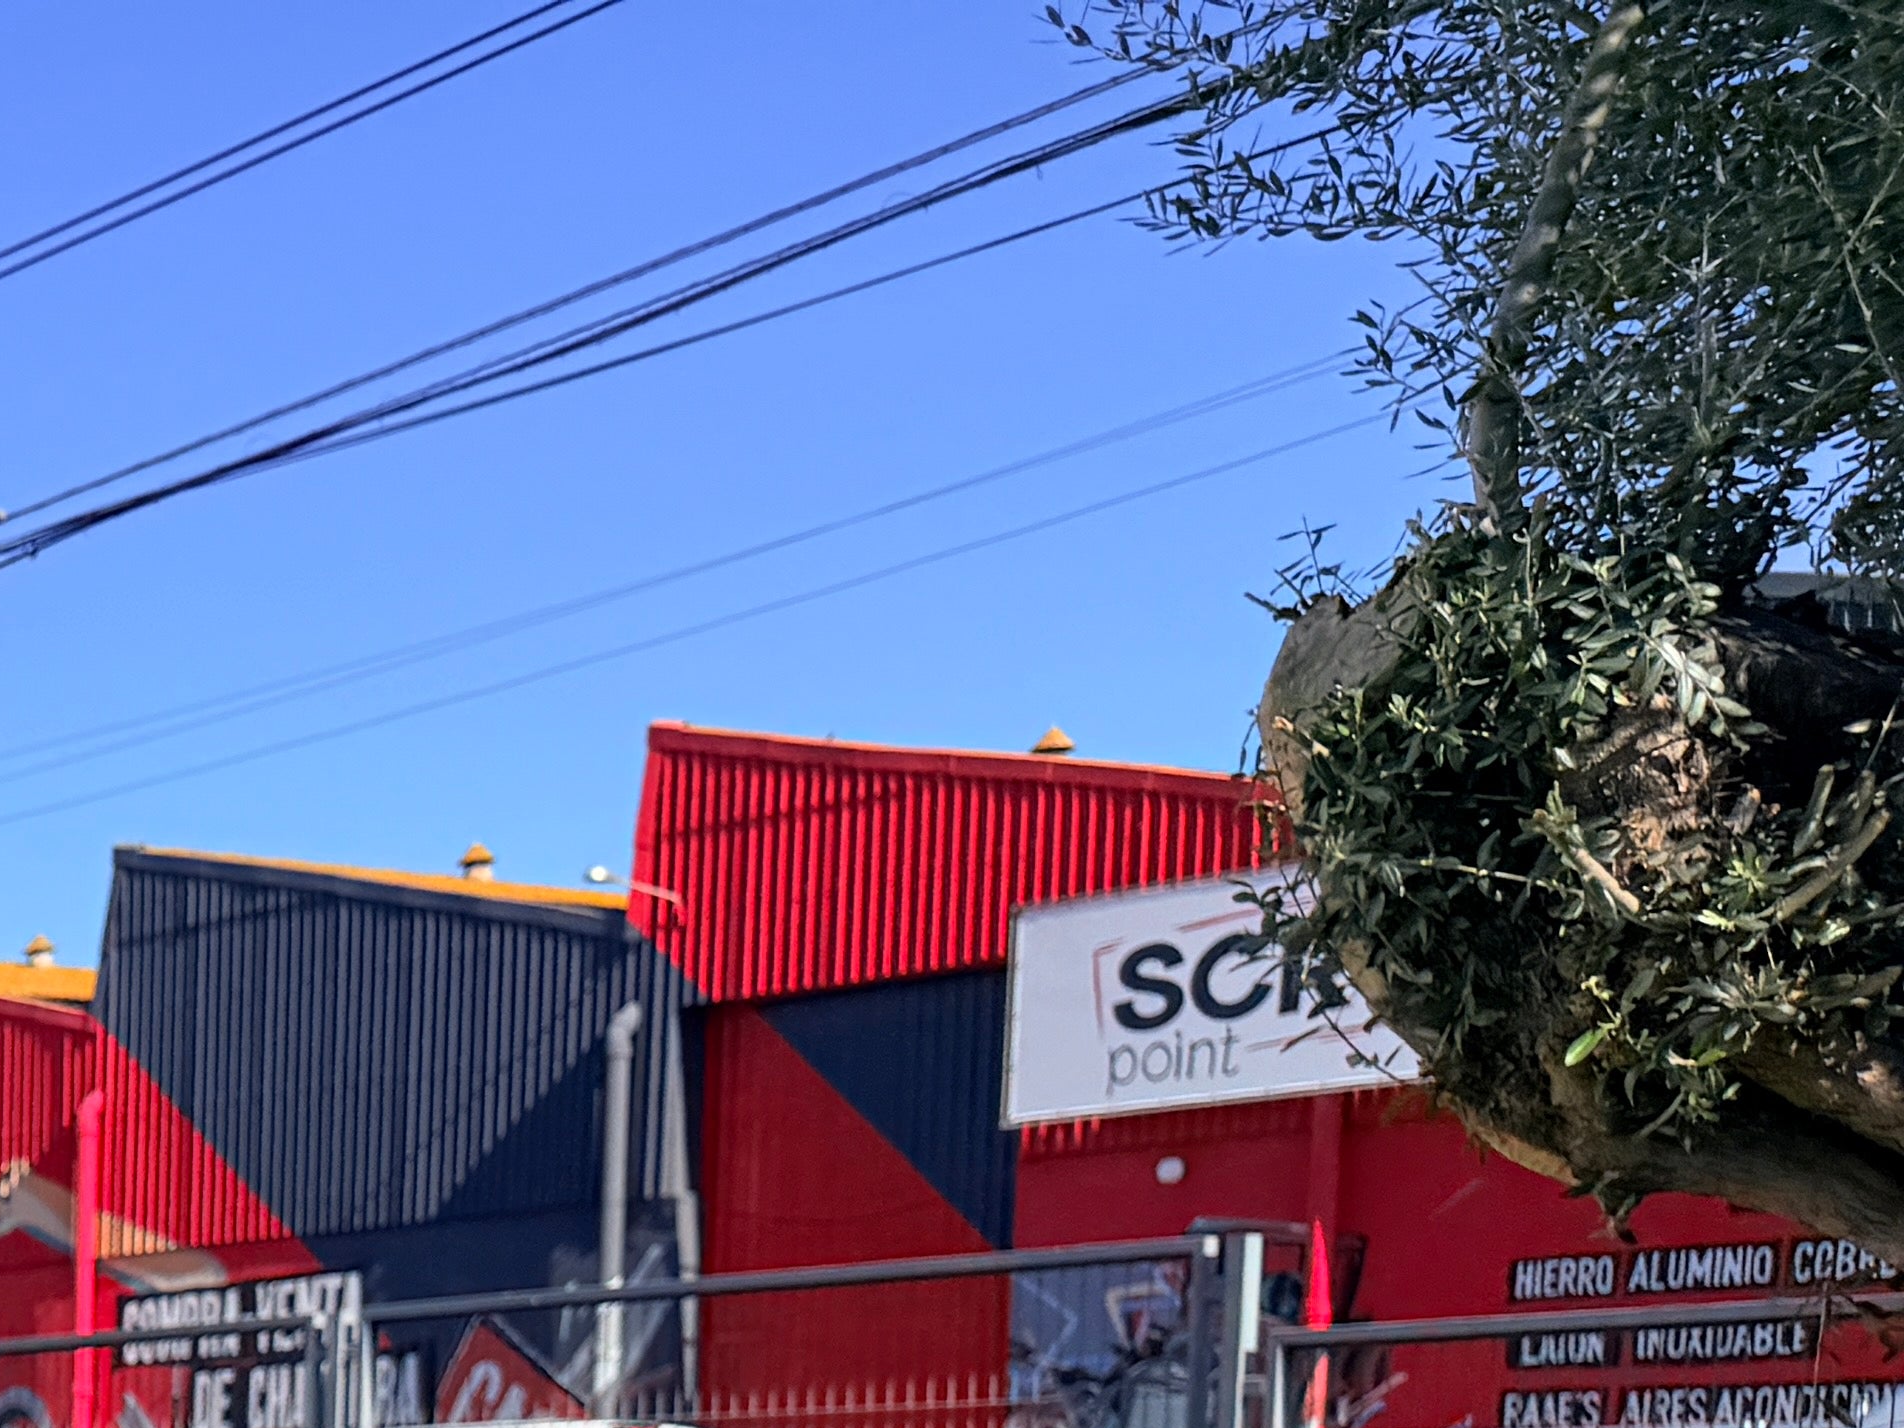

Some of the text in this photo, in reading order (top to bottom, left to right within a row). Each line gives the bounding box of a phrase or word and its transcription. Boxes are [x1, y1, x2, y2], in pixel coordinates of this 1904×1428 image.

[1106, 1024, 1239, 1095] point
[1513, 1258, 1614, 1299] HIERRO
[1627, 1244, 1774, 1293] ALUMINIO
[1620, 1389, 1707, 1428] AIRES
